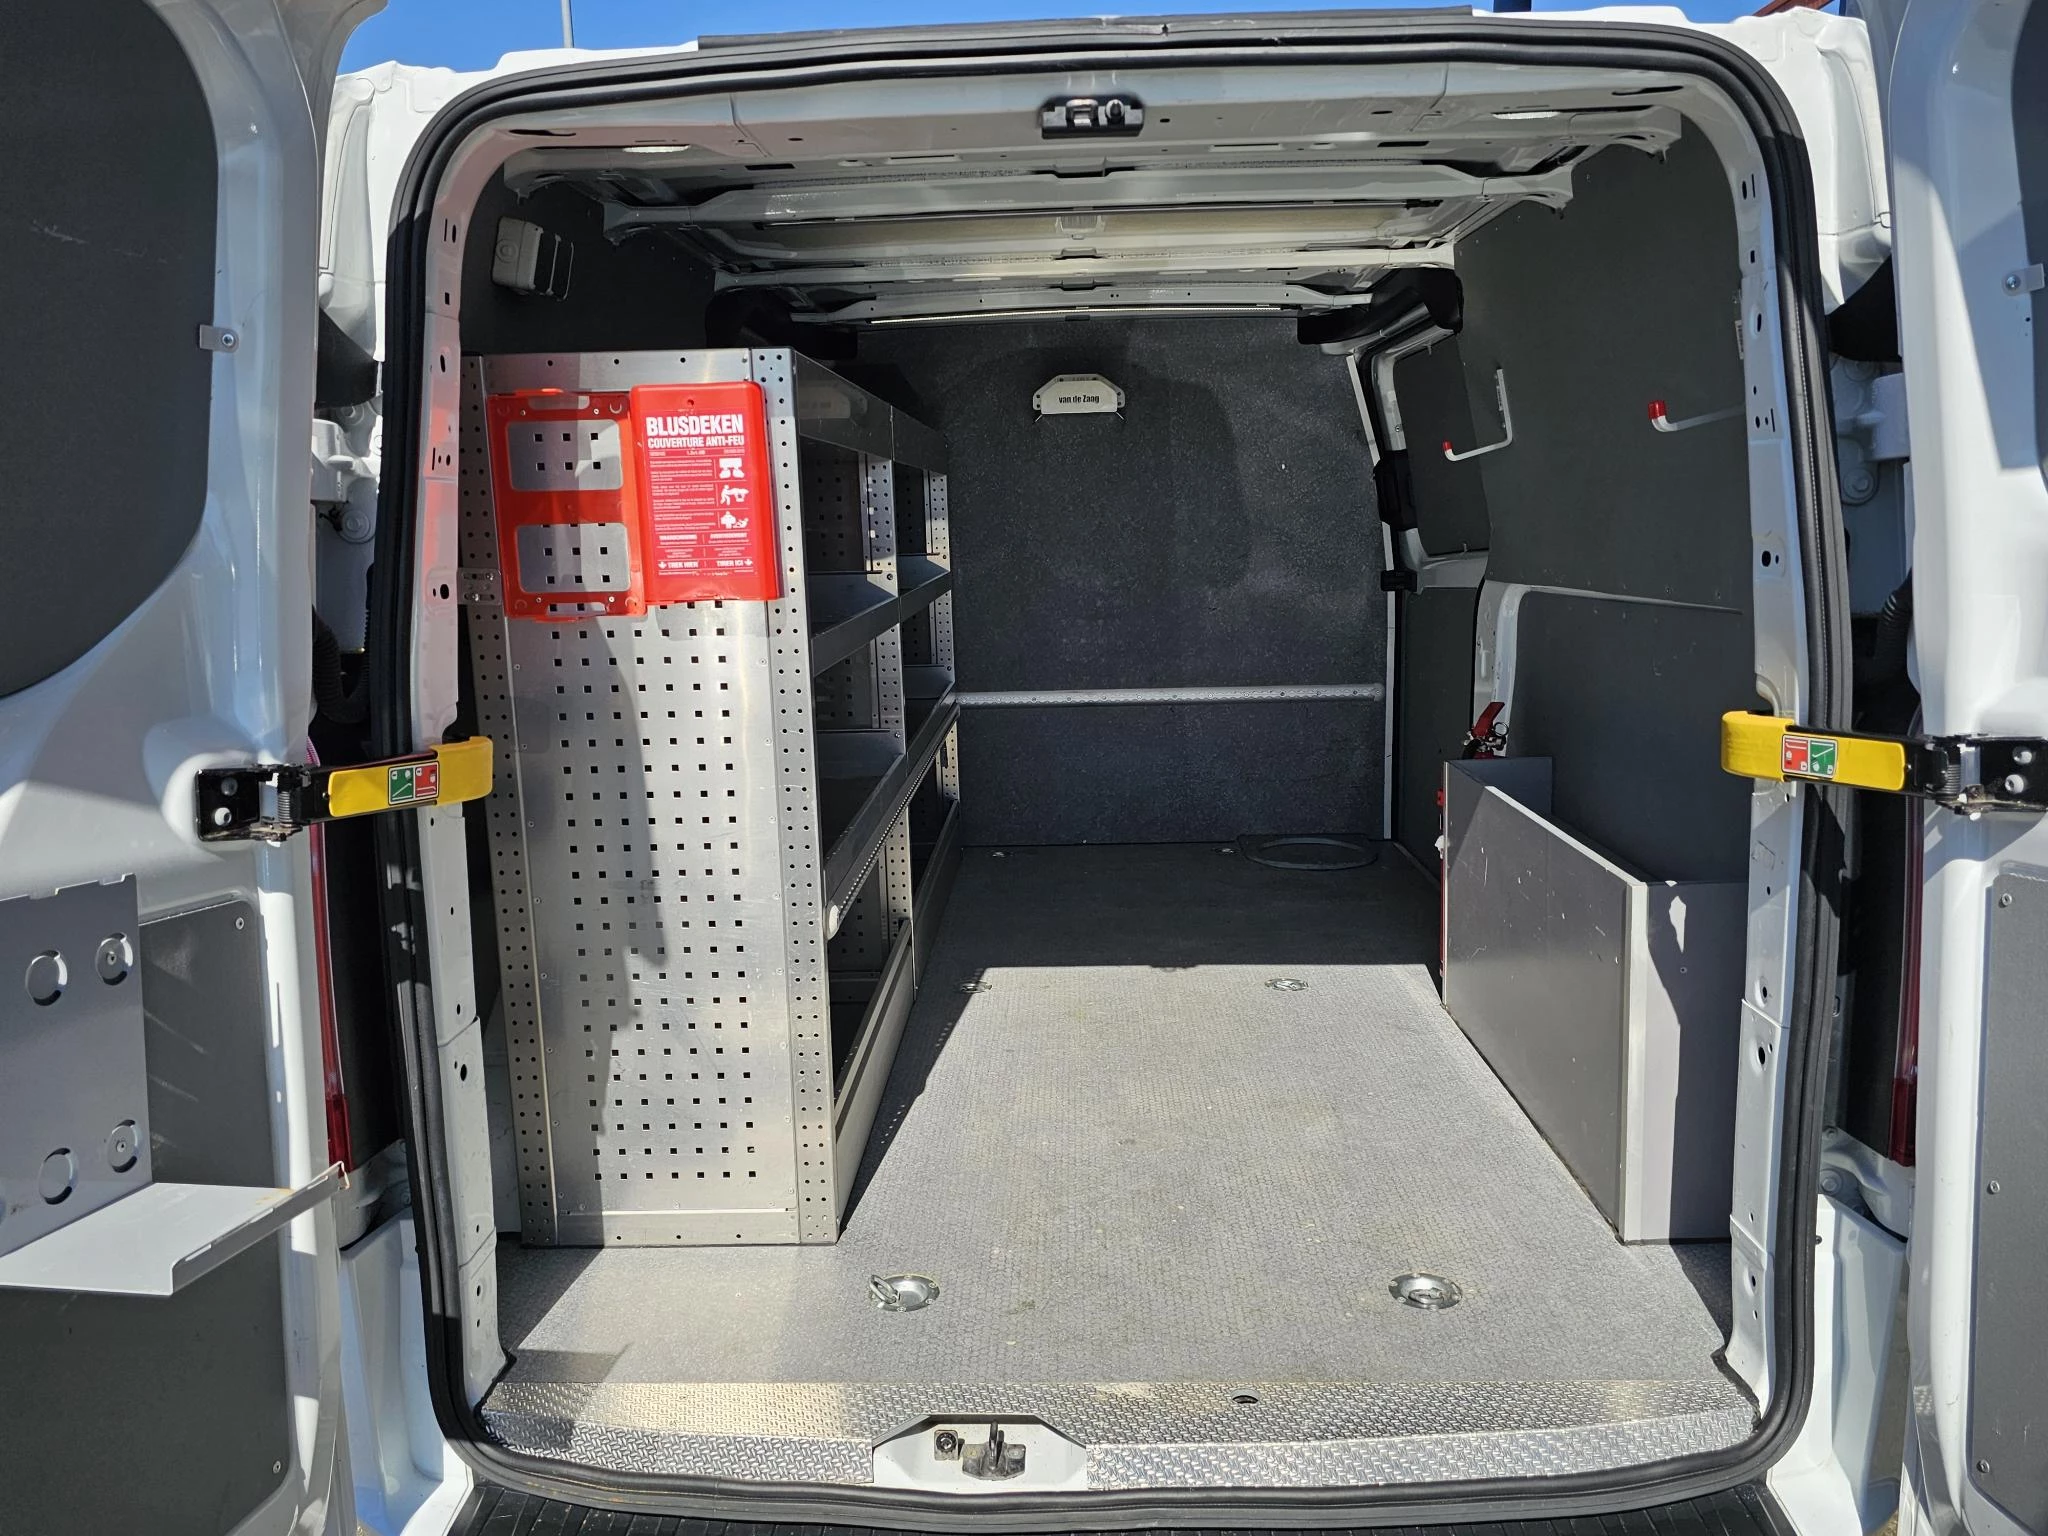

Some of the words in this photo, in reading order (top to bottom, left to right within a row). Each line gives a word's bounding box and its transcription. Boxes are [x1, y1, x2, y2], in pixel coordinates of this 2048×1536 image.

[1058, 396, 1072, 404] van
[1072, 395, 1081, 403] de
[646, 414, 744, 436] BLUSDEKEN
[648, 437, 704, 449] COUVERTURE
[706, 436, 745, 447] ANTI-FEU
